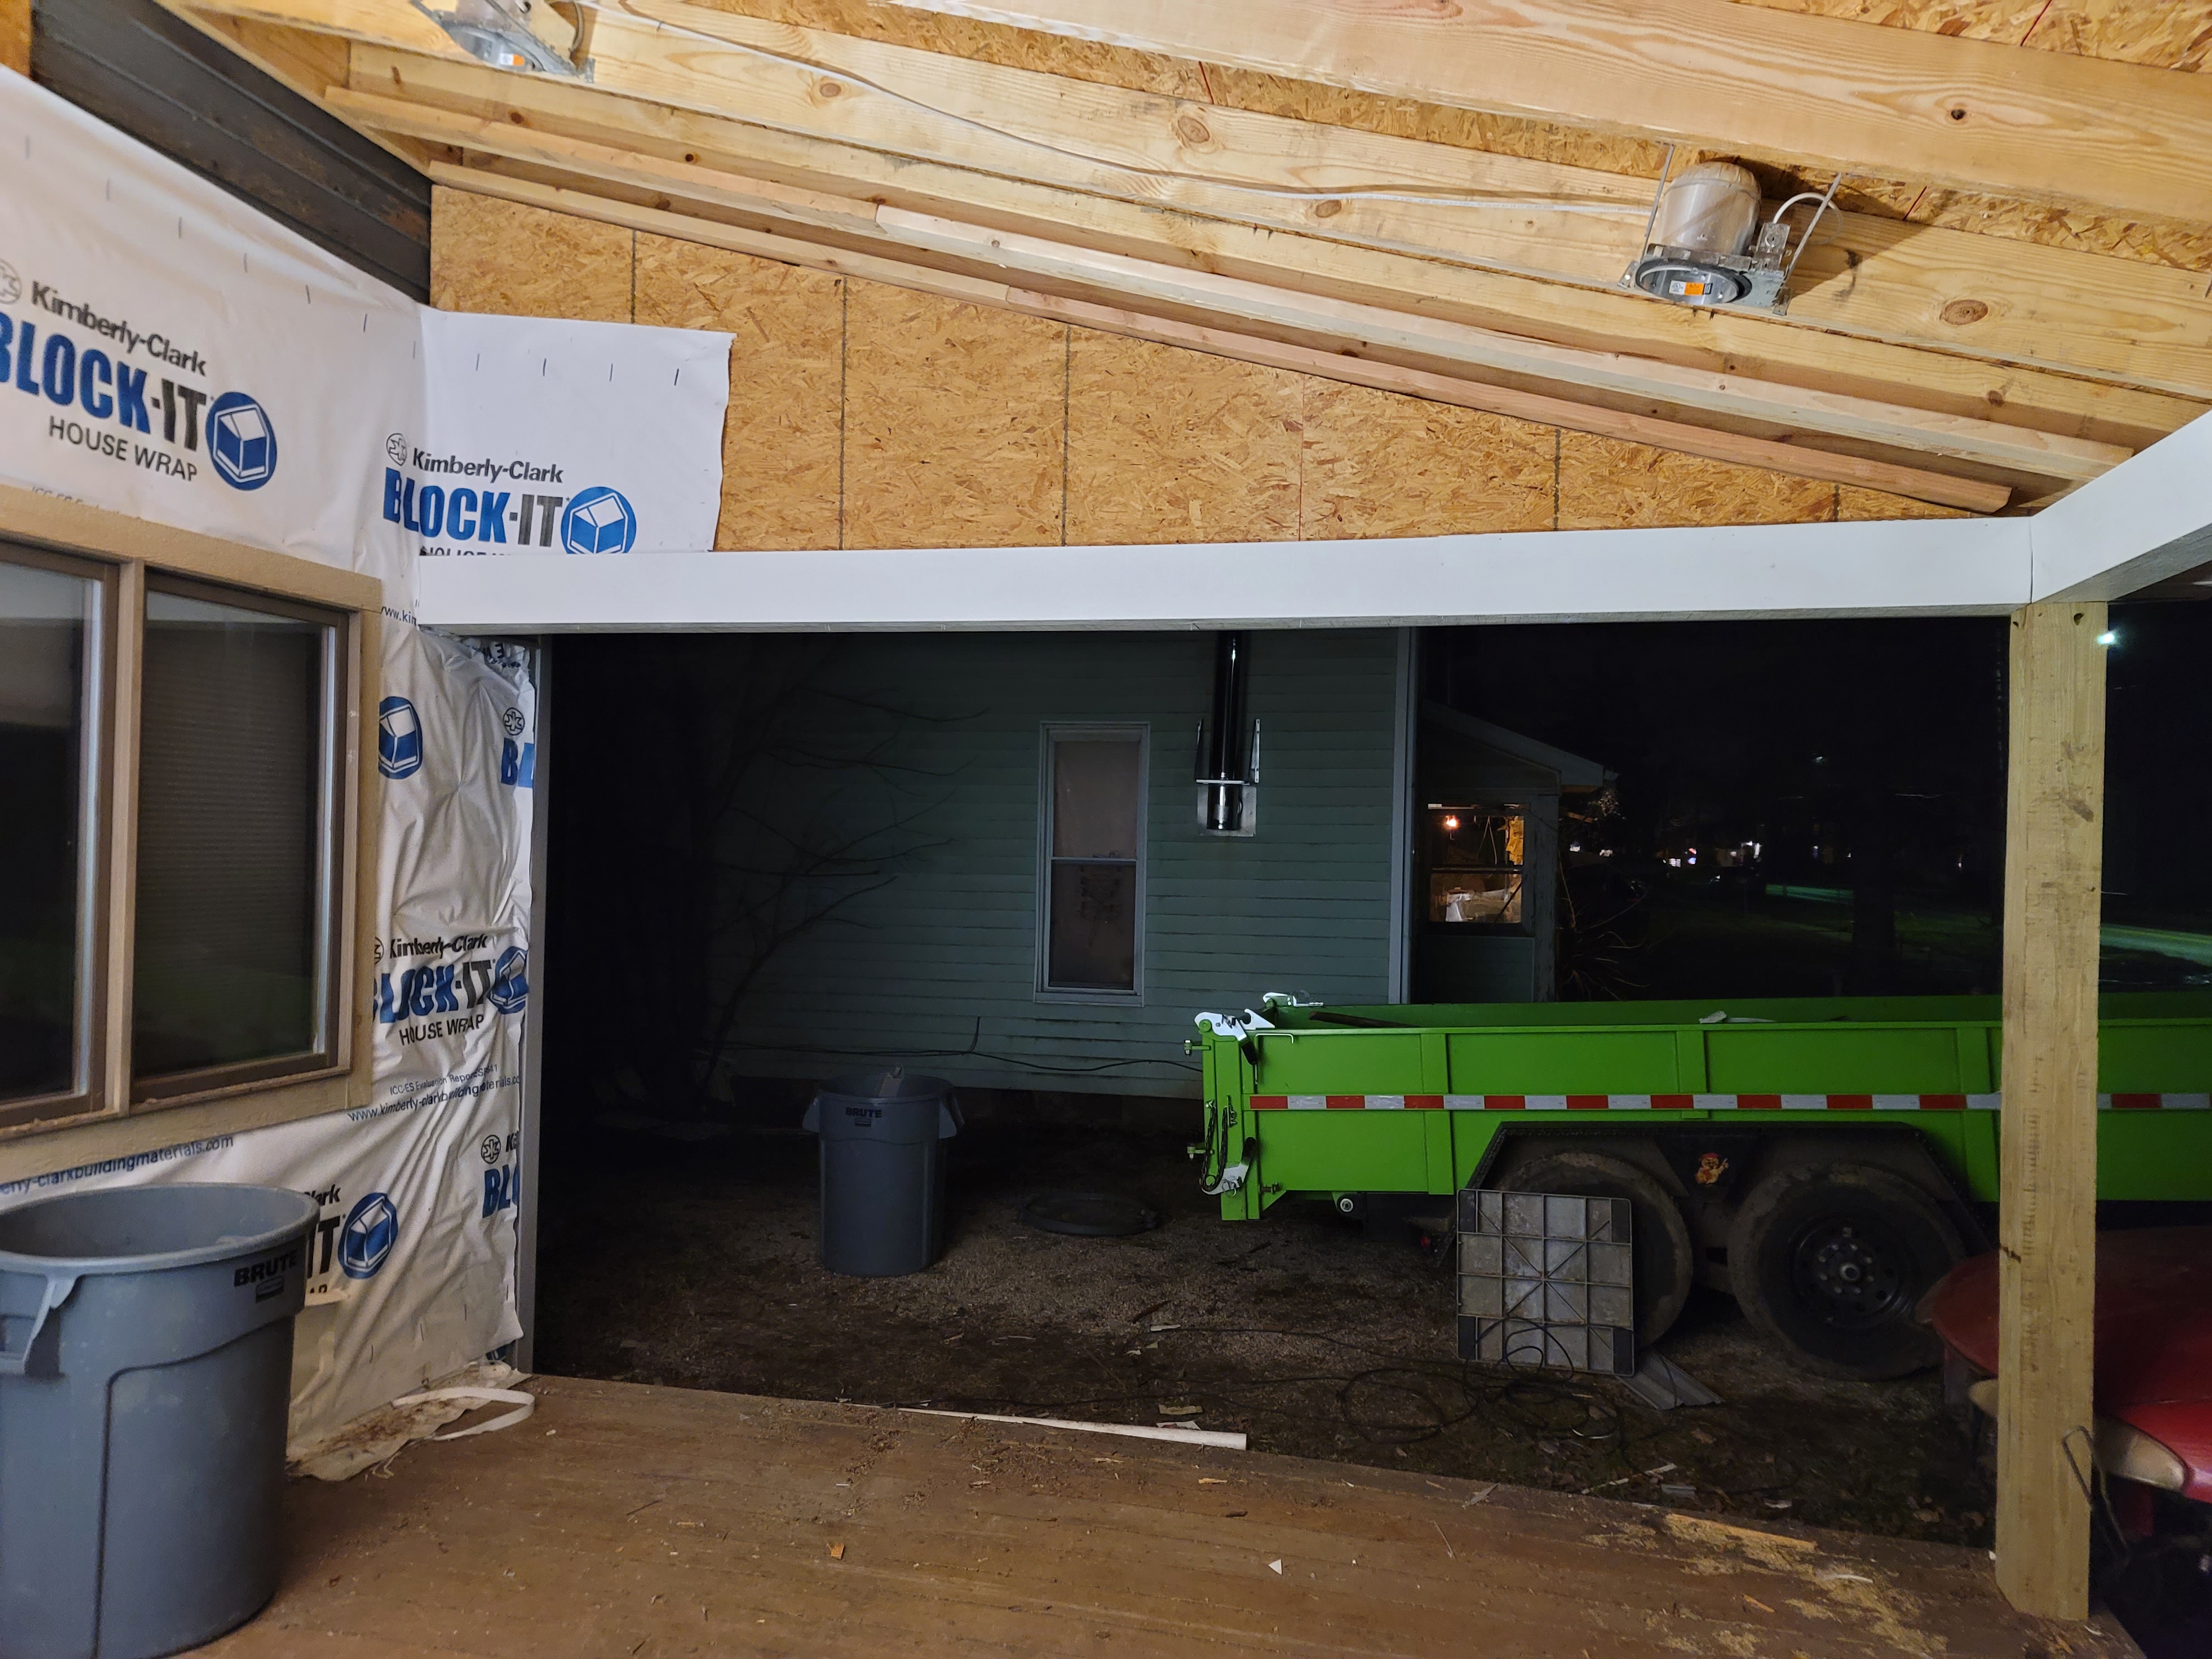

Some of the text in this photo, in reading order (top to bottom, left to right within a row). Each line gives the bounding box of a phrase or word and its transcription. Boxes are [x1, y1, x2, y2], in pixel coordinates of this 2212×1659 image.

[31, 280, 207, 377] Kimberly-Clark
[49, 415, 197, 483] HOUSE WRAP
[413, 447, 564, 484] Kimberly-Clark
[383, 467, 564, 547] BLOCK-IT
[389, 933, 488, 960] Kimberly-Clark
[399, 1014, 484, 1046] HOUSE WRAP
[390, 1082, 414, 1095] ICC-ES
[846, 1107, 883, 1118] BRUTE
[234, 1249, 298, 1287] BRUTE
